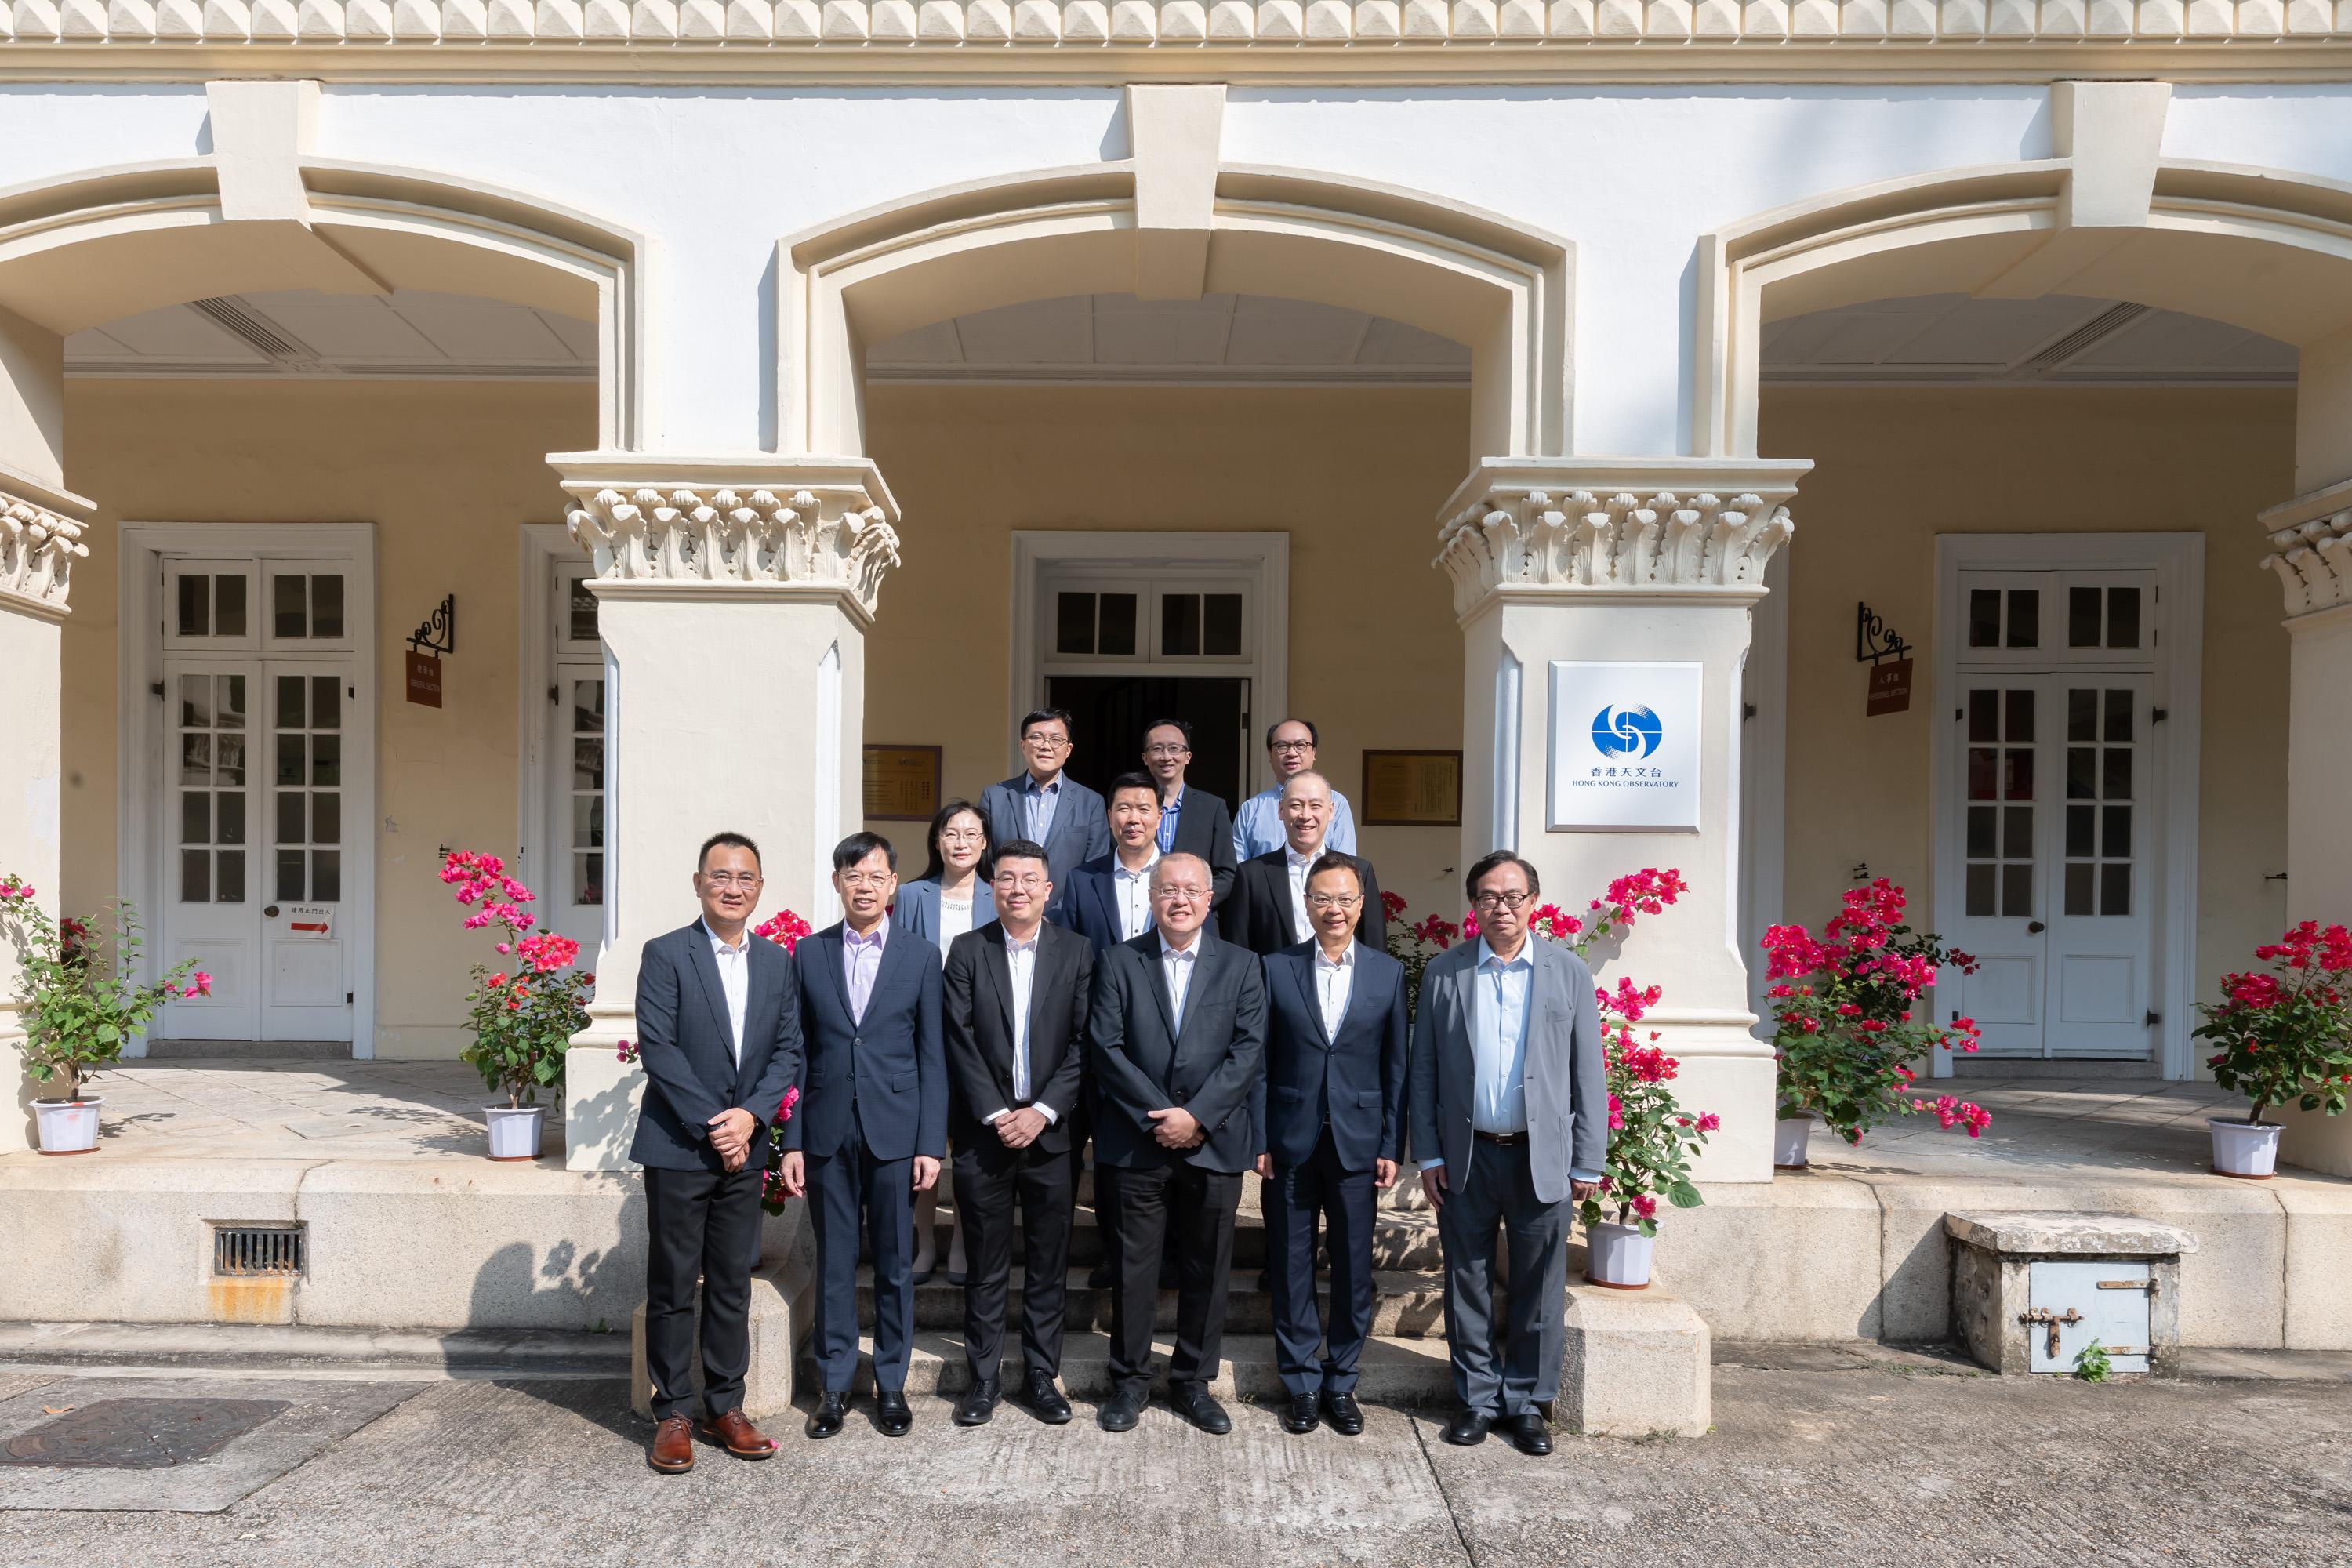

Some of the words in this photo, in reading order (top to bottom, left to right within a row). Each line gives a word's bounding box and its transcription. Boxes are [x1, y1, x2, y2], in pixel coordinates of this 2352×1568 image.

[1591, 767, 1662, 778] 香港天文台
